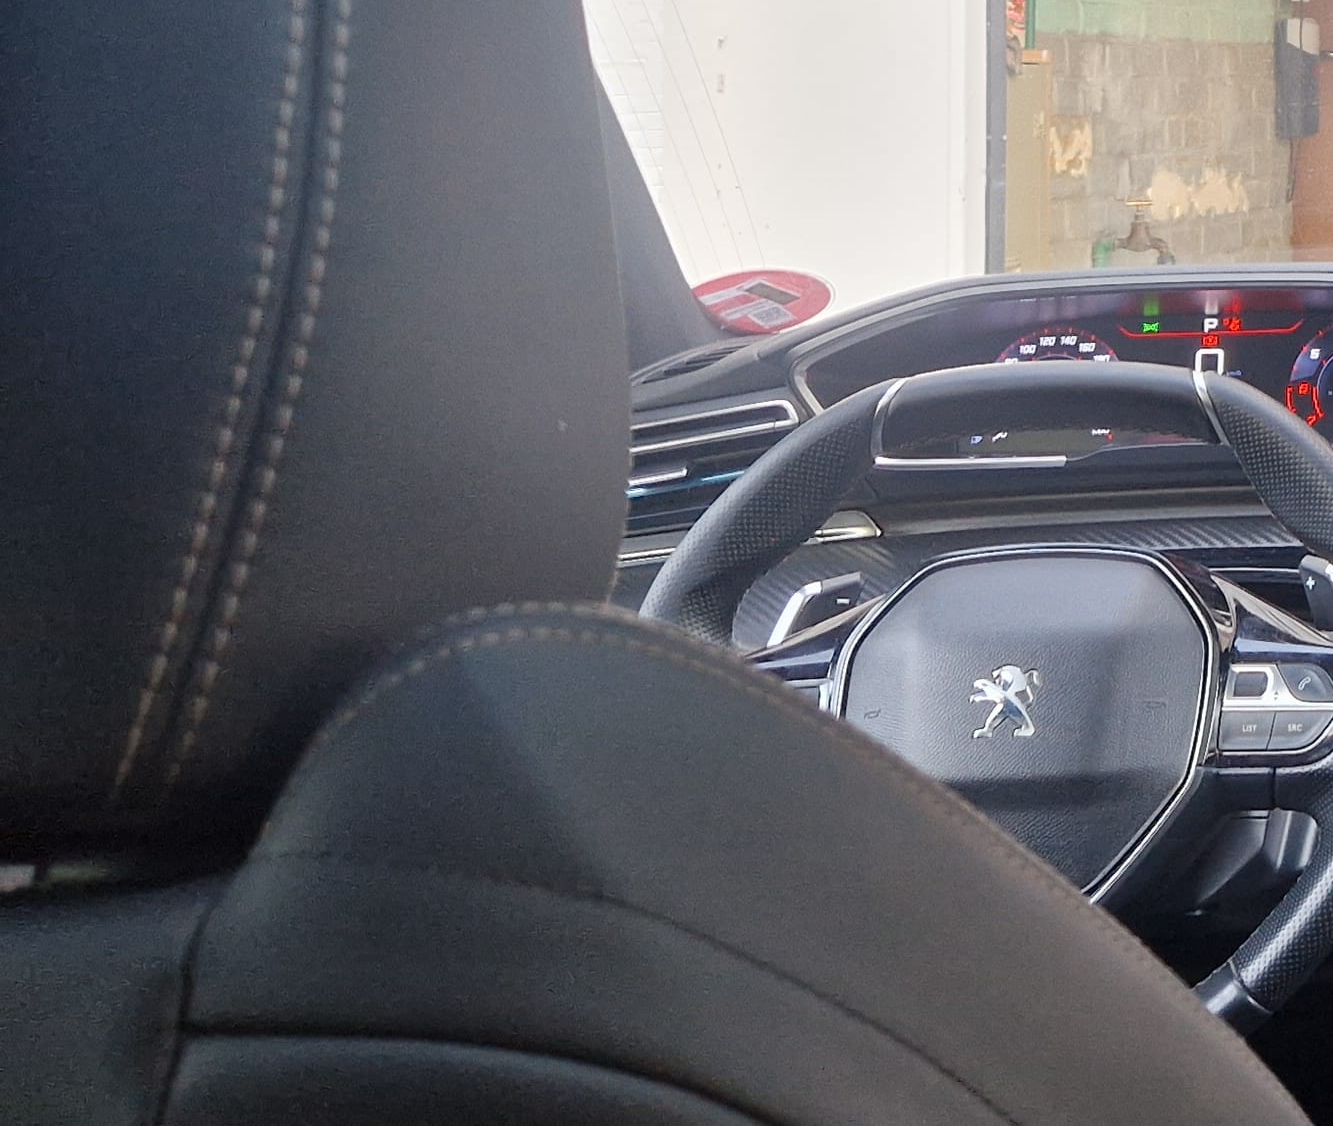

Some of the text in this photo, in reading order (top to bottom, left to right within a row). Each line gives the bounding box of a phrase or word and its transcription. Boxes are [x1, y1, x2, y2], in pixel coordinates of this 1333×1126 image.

[1203, 317, 1219, 333] P
[1039, 336, 1055, 346] 120
[1060, 335, 1077, 346] 140
[1019, 344, 1036, 355] 100
[1078, 342, 1095, 353] 160
[1310, 349, 1320, 359] 5
[1242, 724, 1258, 732] LIST
[1287, 723, 1303, 732] SRC
